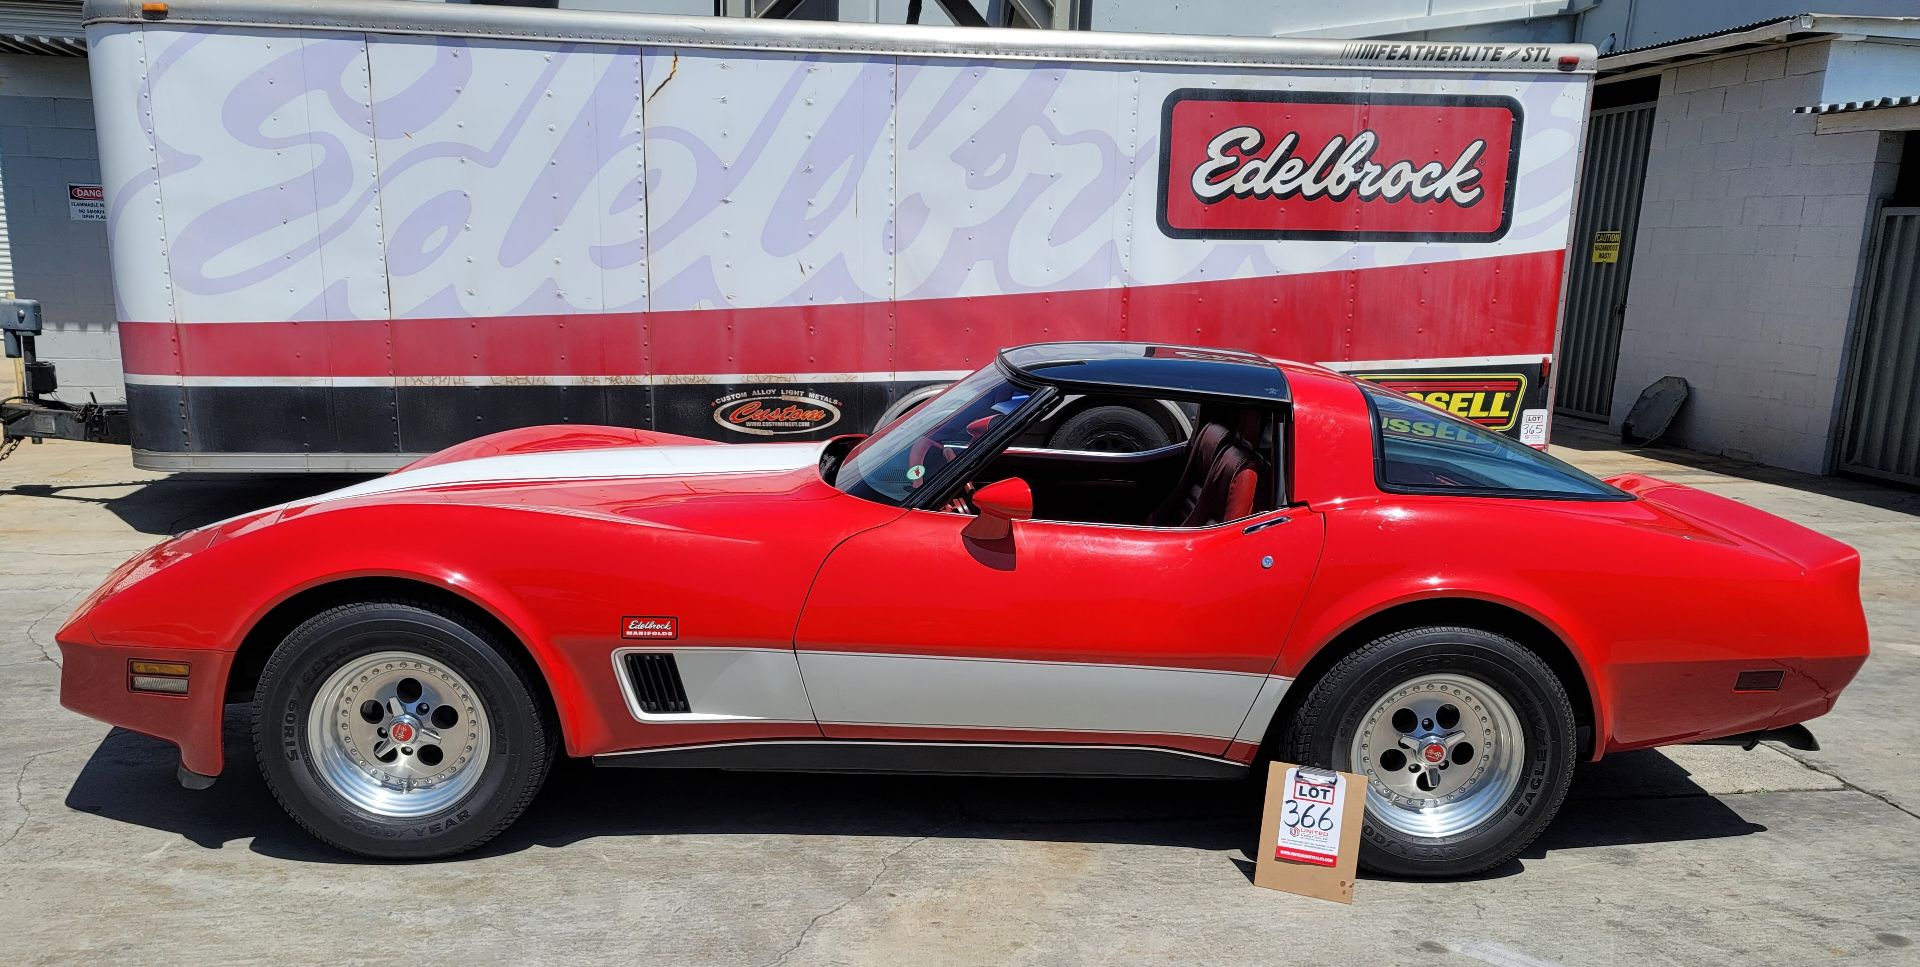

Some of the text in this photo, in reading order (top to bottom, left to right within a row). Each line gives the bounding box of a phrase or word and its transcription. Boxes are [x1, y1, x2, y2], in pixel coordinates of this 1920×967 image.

[1375, 44, 1551, 62] FEATHERLITE STL
[1191, 126, 1486, 208] Edelbrock
[78, 189, 101, 197] DANG
[1597, 233, 1619, 241] CAUTION
[715, 391, 748, 404] CUSTOM
[781, 389, 804, 397] LIGHT
[808, 392, 838, 405] METALS
[729, 401, 826, 423] Custom
[1523, 424, 1543, 434] 365
[628, 620, 671, 630] Edelbrock
[1299, 786, 1330, 799] LOT
[1284, 800, 1333, 831] 366
